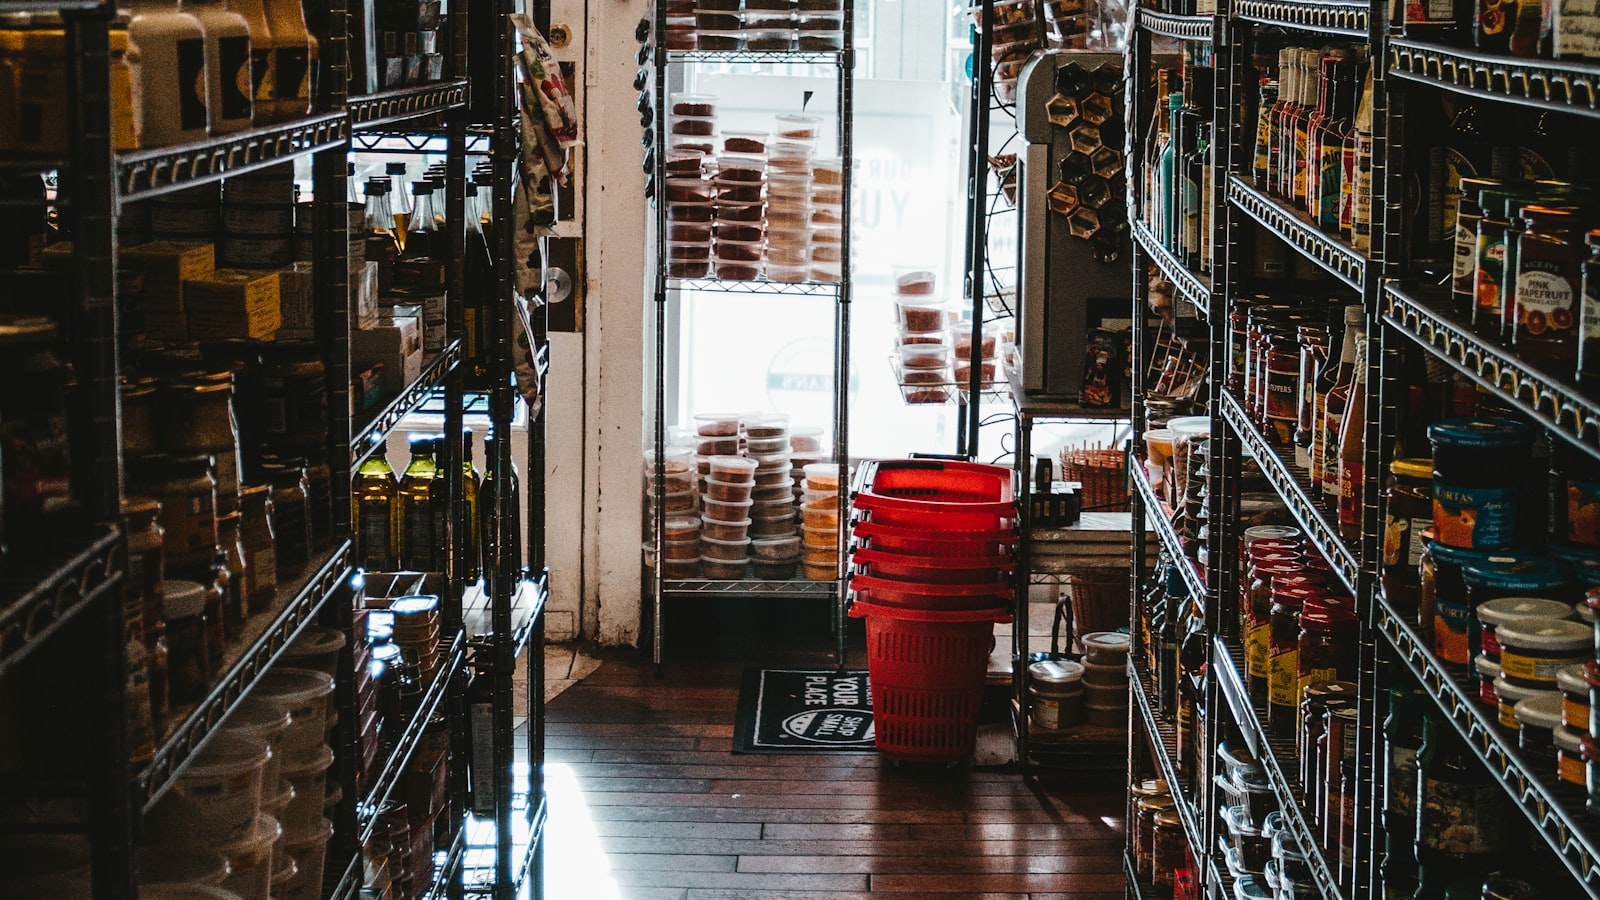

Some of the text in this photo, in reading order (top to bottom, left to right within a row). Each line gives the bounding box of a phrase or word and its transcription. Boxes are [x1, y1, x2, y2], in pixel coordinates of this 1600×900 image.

[1518, 287, 1570, 300] RAPEFRUIT
[1528, 280, 1549, 290] PINK
[804, 676, 828, 706] PLACE
[832, 676, 859, 706] YOUR
[814, 713, 844, 736] SMALL
[837, 716, 863, 737] SHOP
